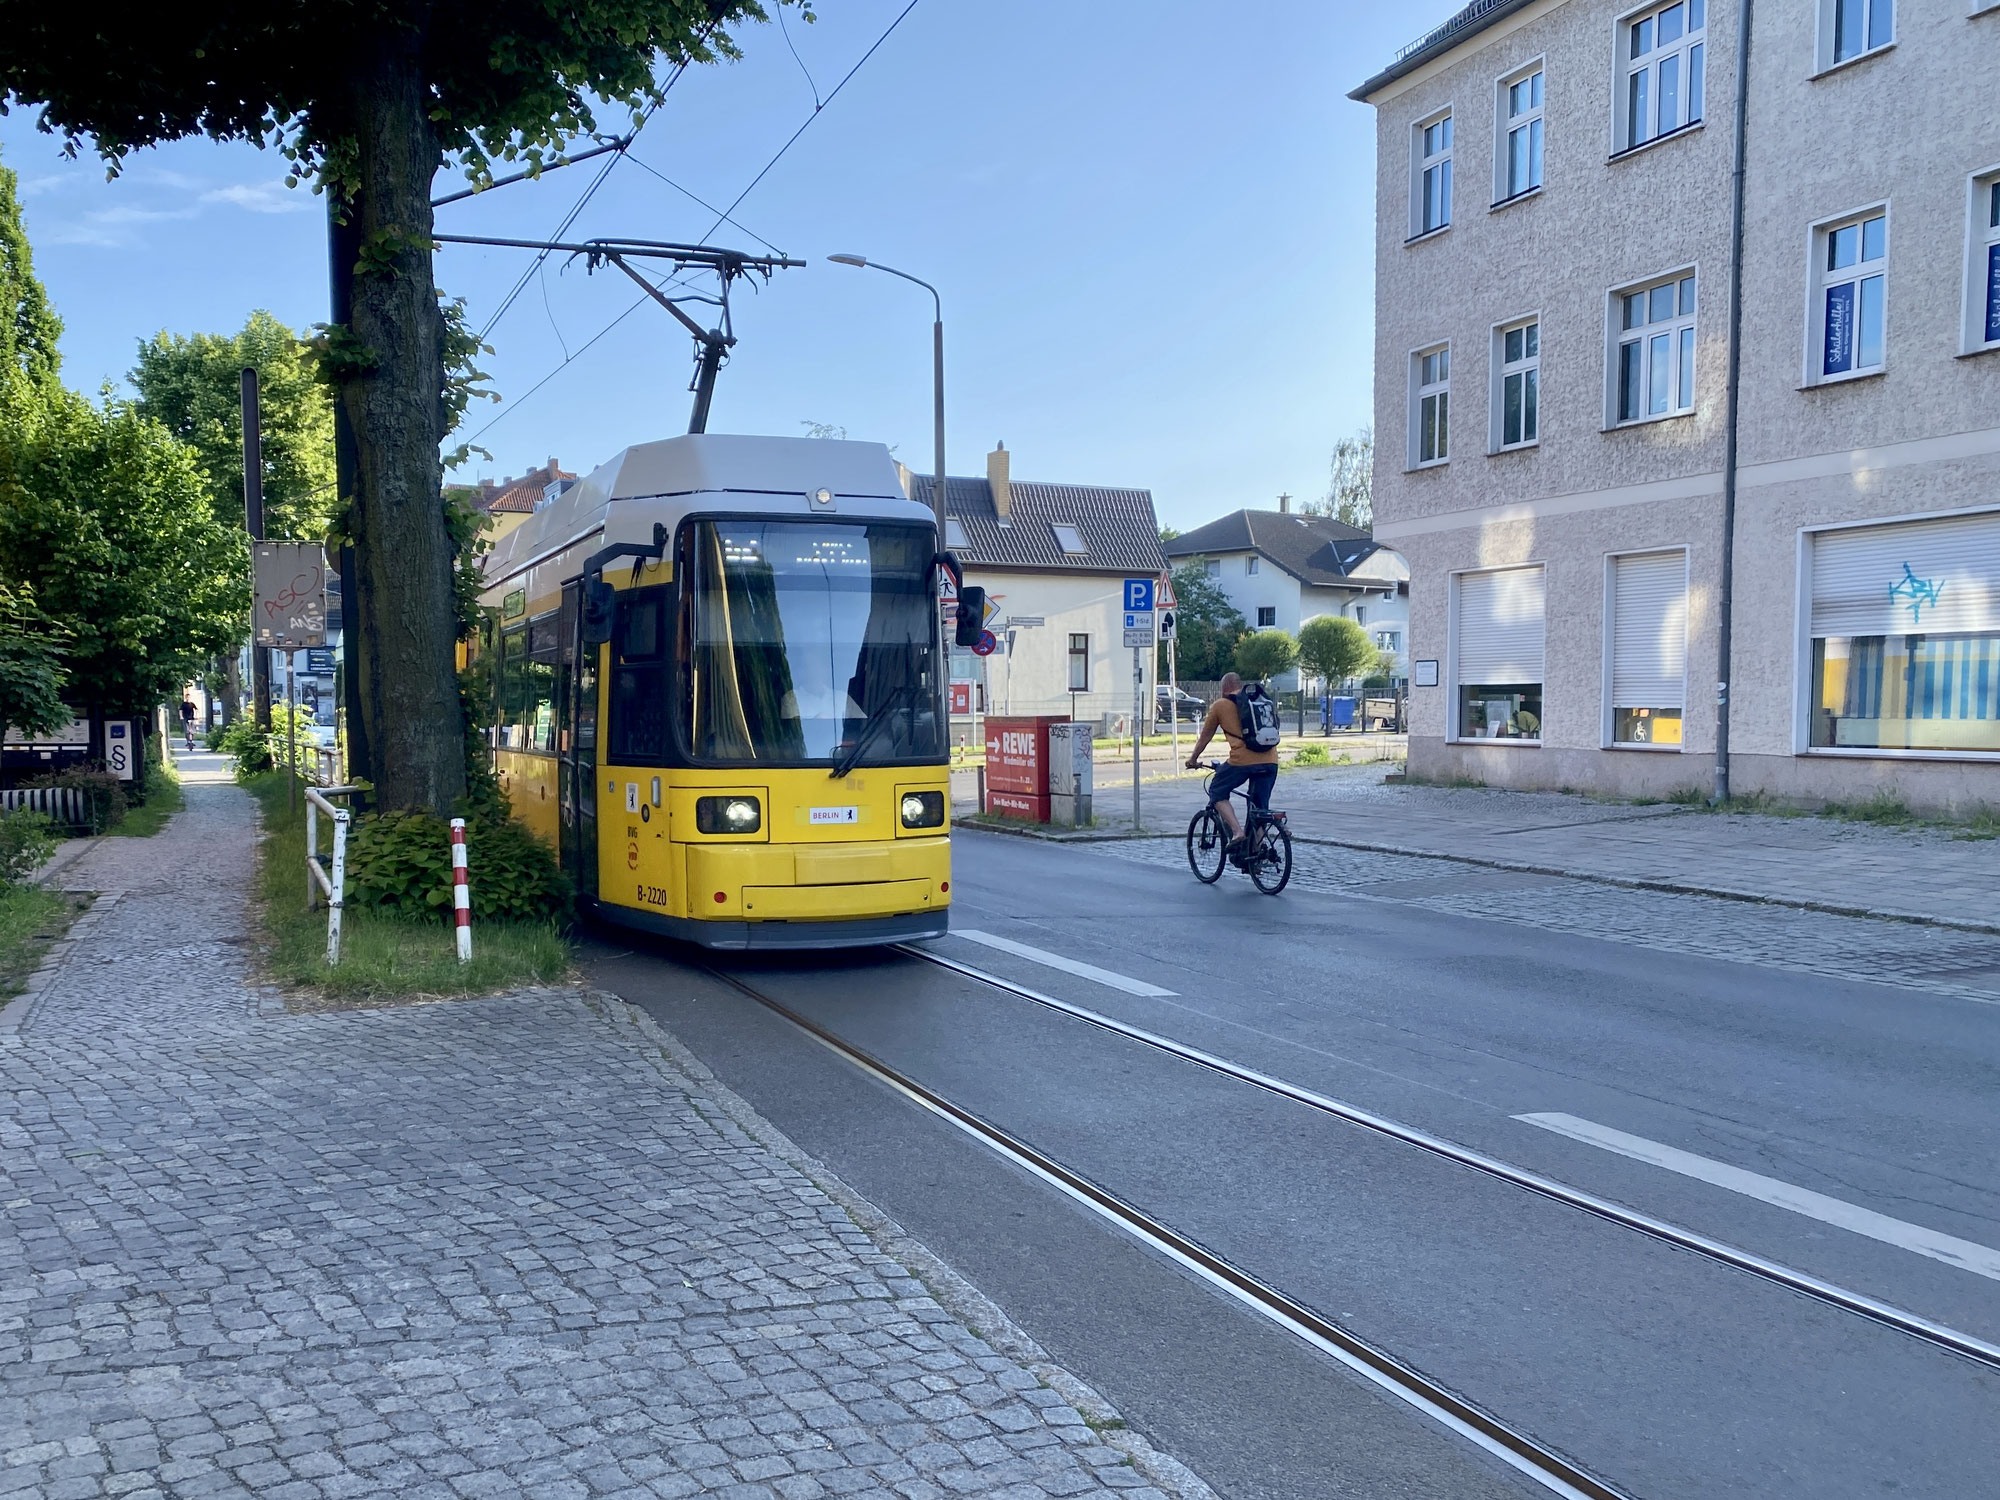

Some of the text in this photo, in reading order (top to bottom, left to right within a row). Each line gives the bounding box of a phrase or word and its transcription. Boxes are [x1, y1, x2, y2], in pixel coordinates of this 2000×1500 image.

[1130, 583, 1147, 608] P
[1002, 731, 1036, 756] REWE
[813, 811, 840, 820] BERLIN
[627, 826, 638, 839] BVG
[637, 884, 667, 906] B-2220
